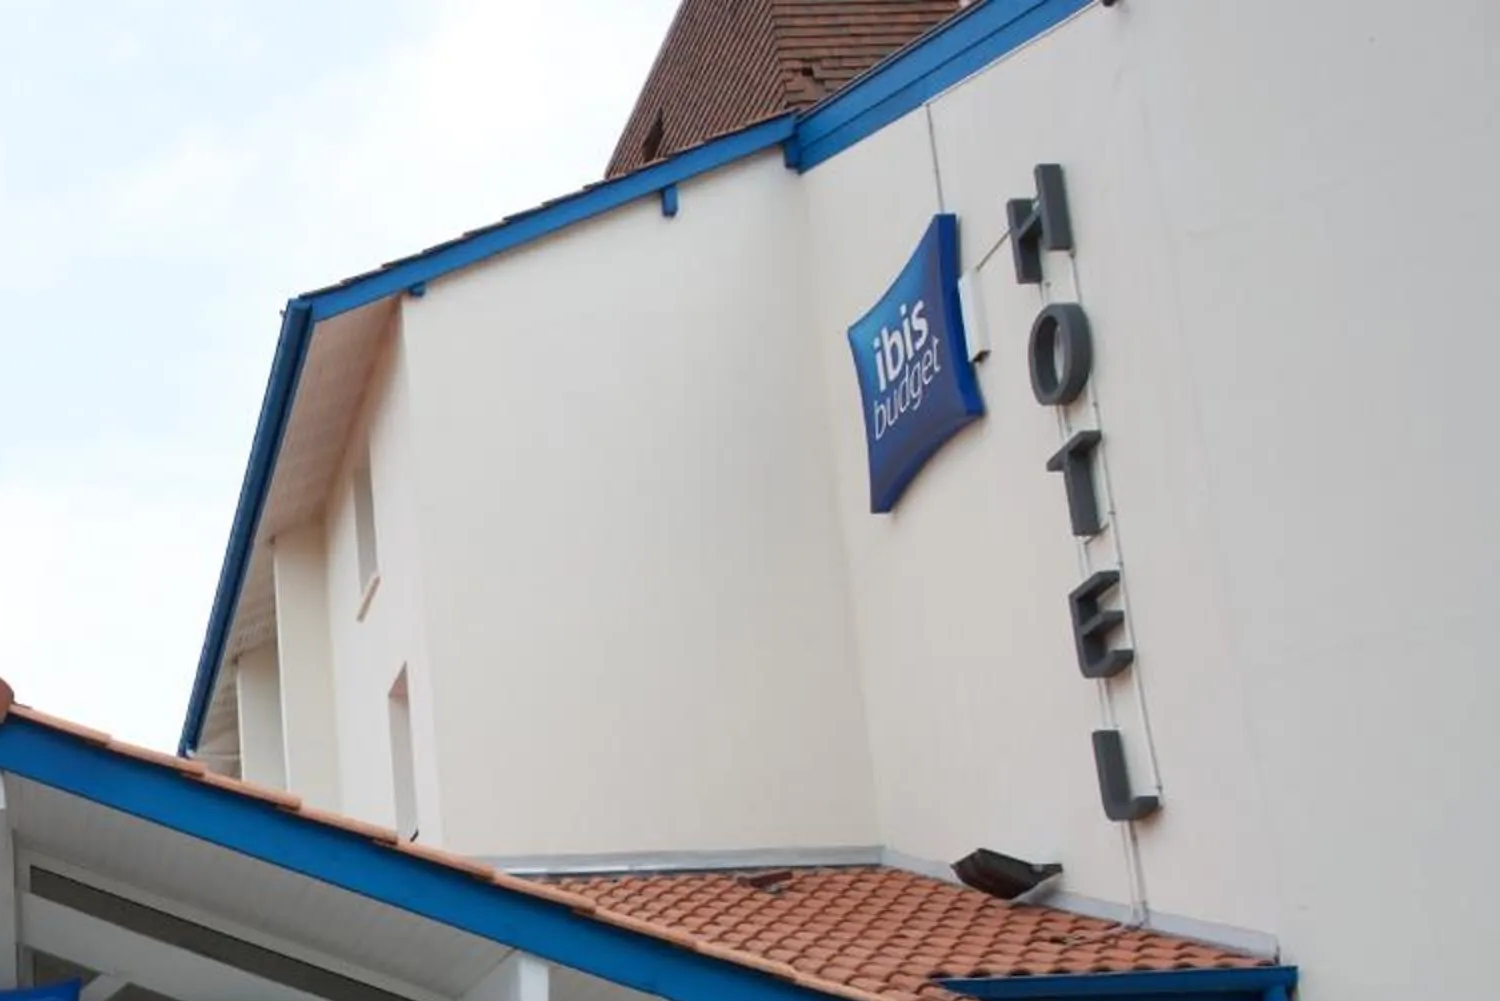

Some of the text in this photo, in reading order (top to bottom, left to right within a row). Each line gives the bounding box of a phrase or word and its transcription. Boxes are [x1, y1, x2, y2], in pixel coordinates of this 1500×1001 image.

[873, 300, 928, 392] ibis
[873, 336, 942, 441] budget
[1007, 163, 1160, 822] HOTEL
